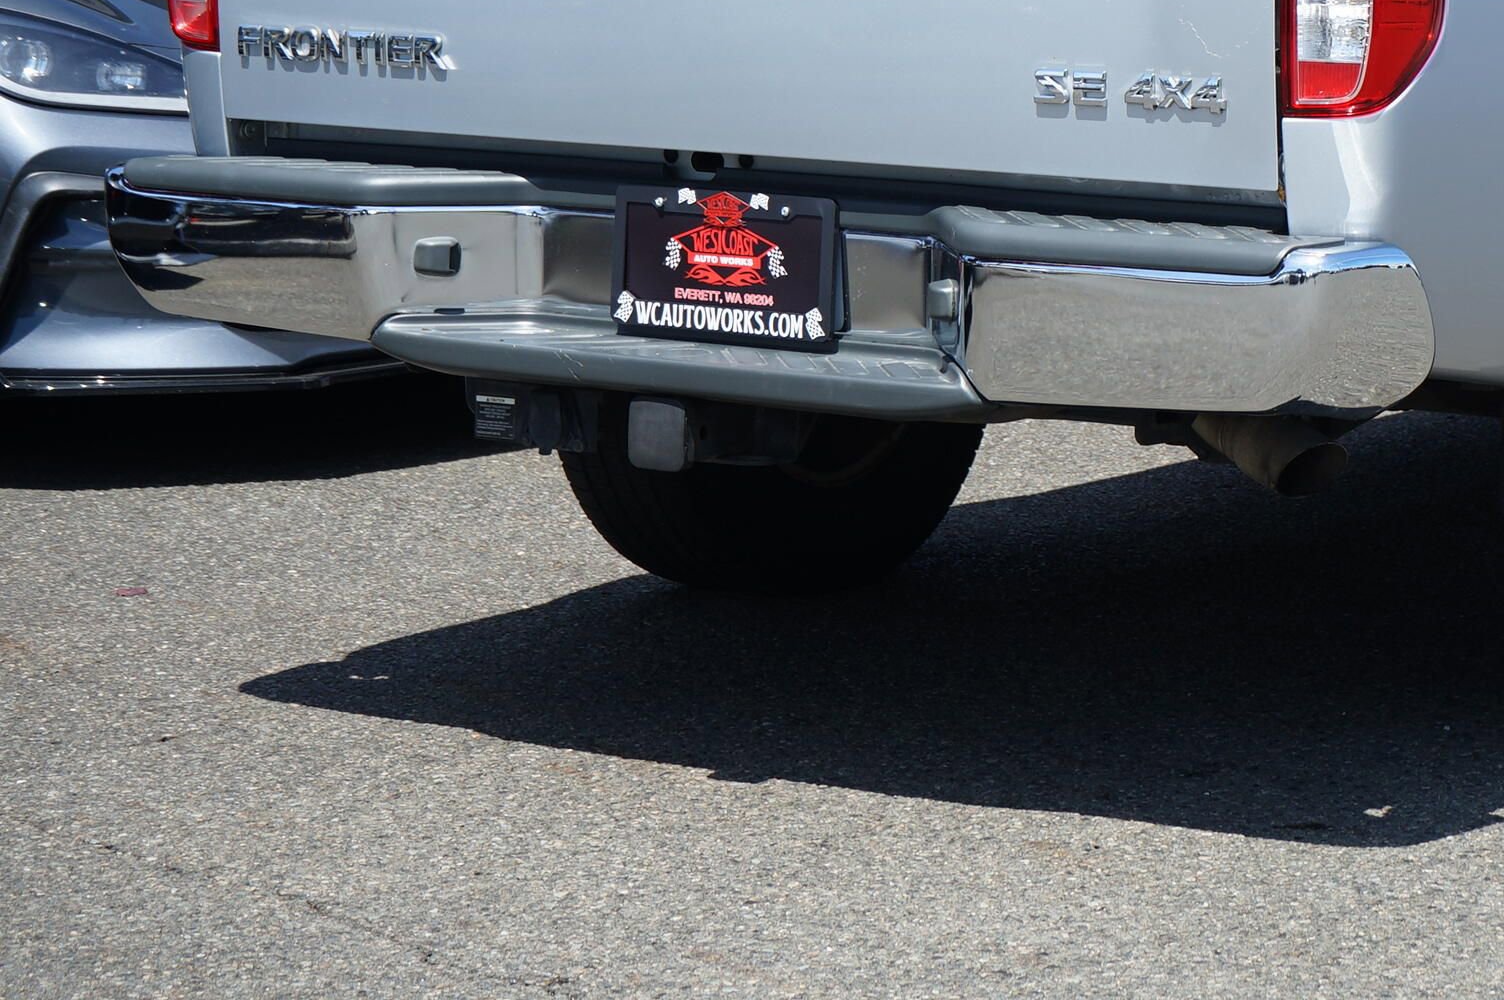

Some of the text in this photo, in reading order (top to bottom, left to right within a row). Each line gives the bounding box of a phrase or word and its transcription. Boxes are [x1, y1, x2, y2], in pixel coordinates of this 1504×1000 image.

[238, 24, 456, 70] FRONTIER
[1034, 68, 1107, 107] SE
[693, 254, 753, 267] AUTO WORKS
[674, 287, 723, 304] EVERETT,
[724, 292, 743, 305] WA
[635, 300, 803, 339] WCAUTOWORKS.COM
